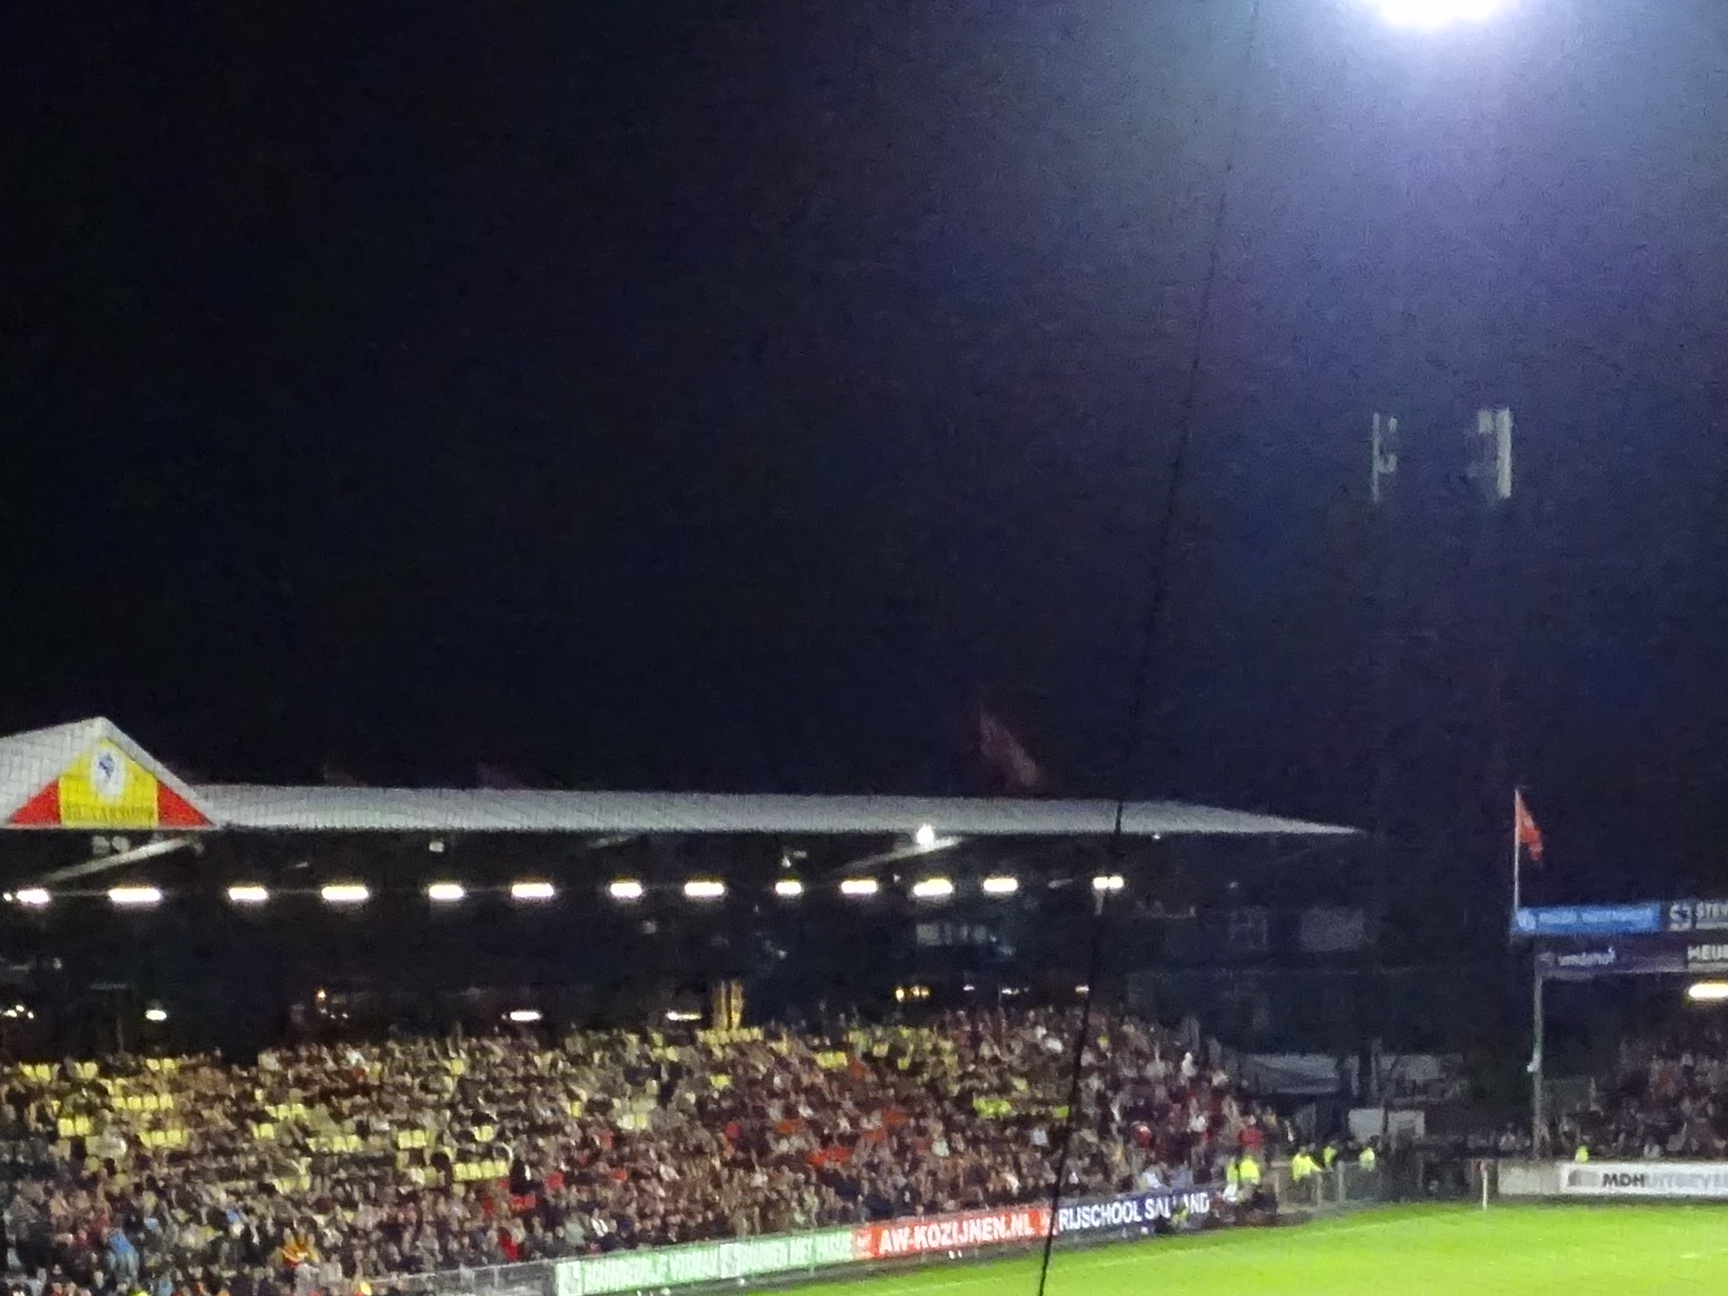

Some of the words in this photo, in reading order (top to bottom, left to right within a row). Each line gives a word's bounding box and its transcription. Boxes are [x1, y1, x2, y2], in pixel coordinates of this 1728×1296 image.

[1601, 1172, 1645, 1189] MDH
[1058, 1199, 1143, 1232] RIJSCHOOL
[1144, 1191, 1211, 1221] SALAND
[878, 1212, 1036, 1253] AW-KOZIJNEN.NL
